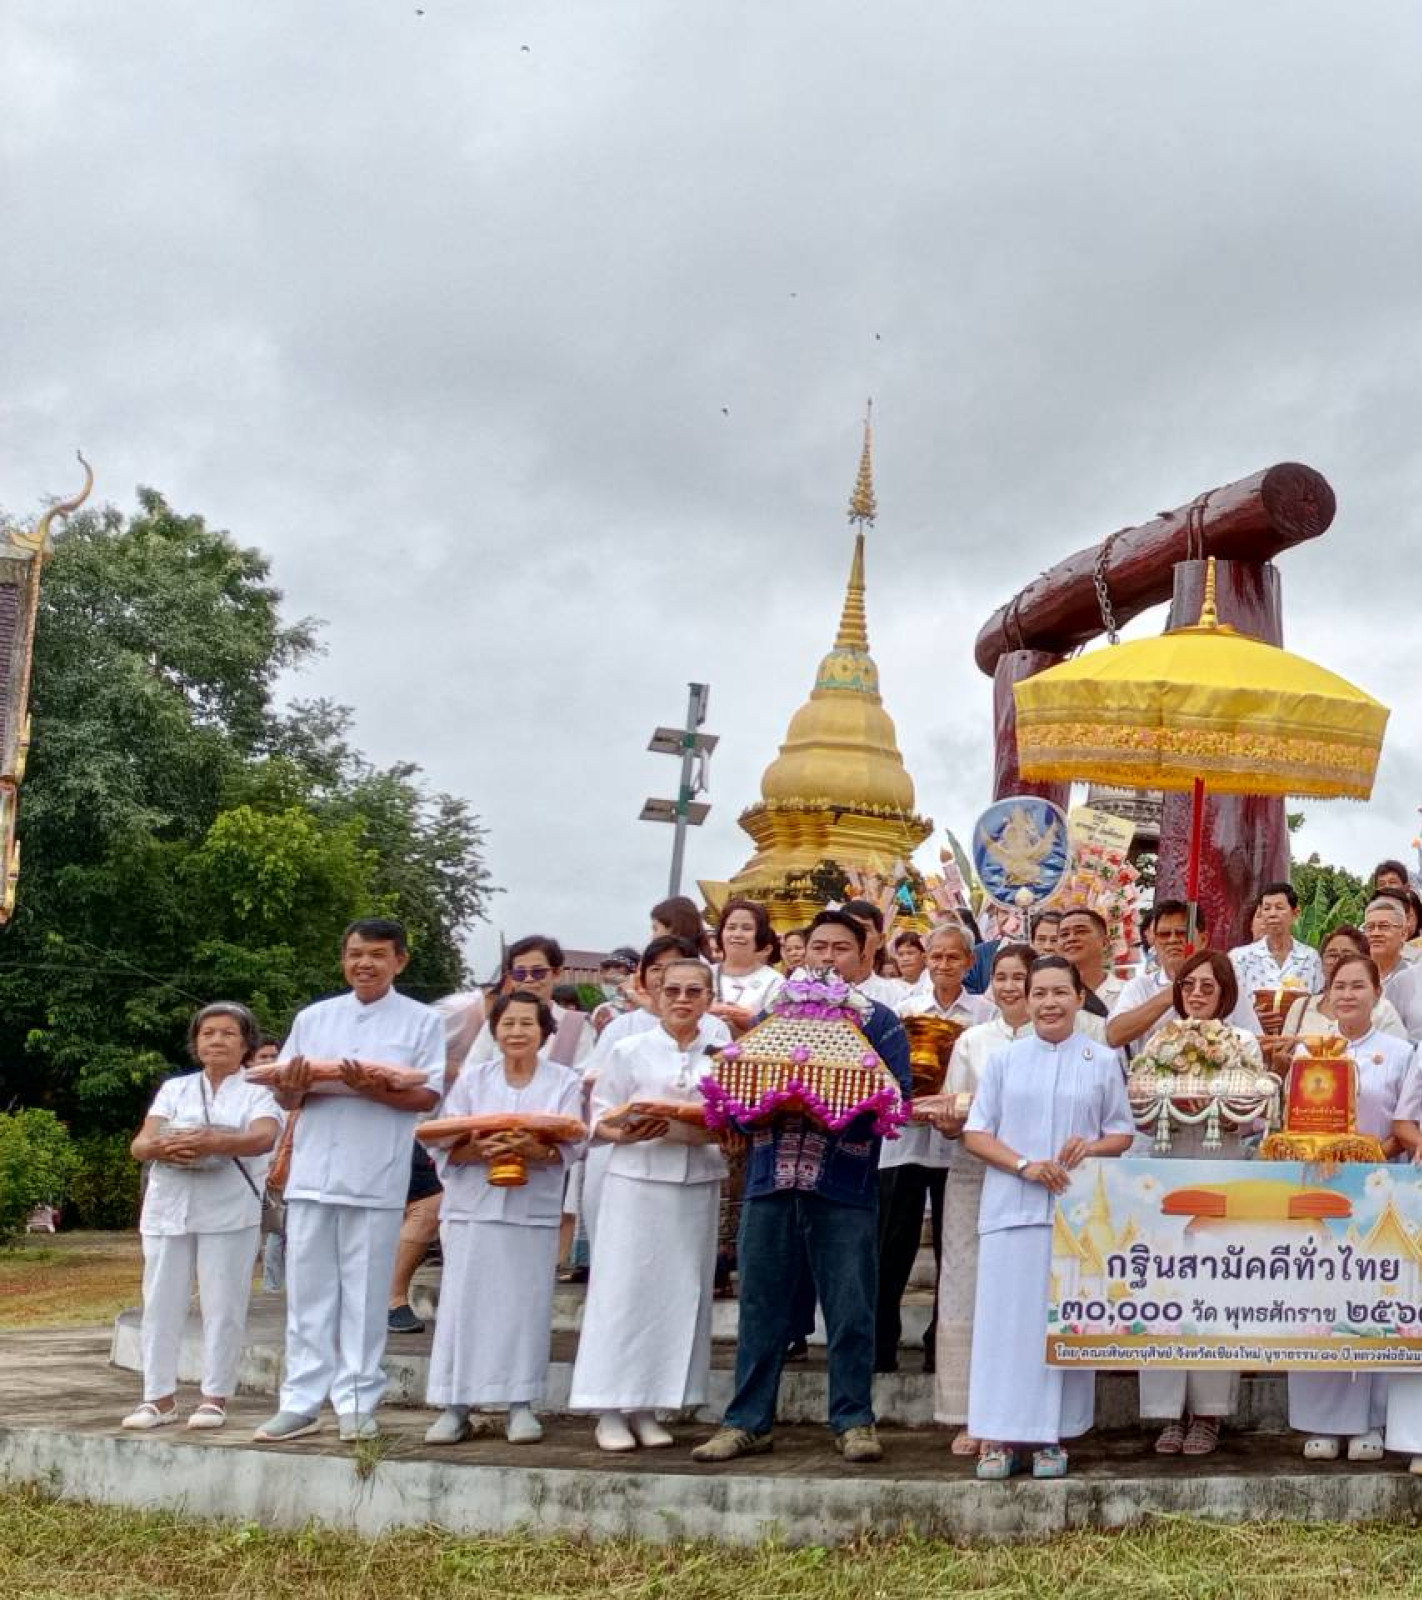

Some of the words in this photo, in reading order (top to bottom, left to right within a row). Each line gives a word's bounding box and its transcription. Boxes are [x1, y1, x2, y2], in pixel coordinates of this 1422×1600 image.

[1107, 1236, 1400, 1288] กฐินสามัคคีทั่วไทย
[1061, 1299, 1183, 1327] ๓๐,๐๐๐
[1192, 1299, 1217, 1323] วัด
[1225, 1298, 1336, 1331] พุทธศักราช
